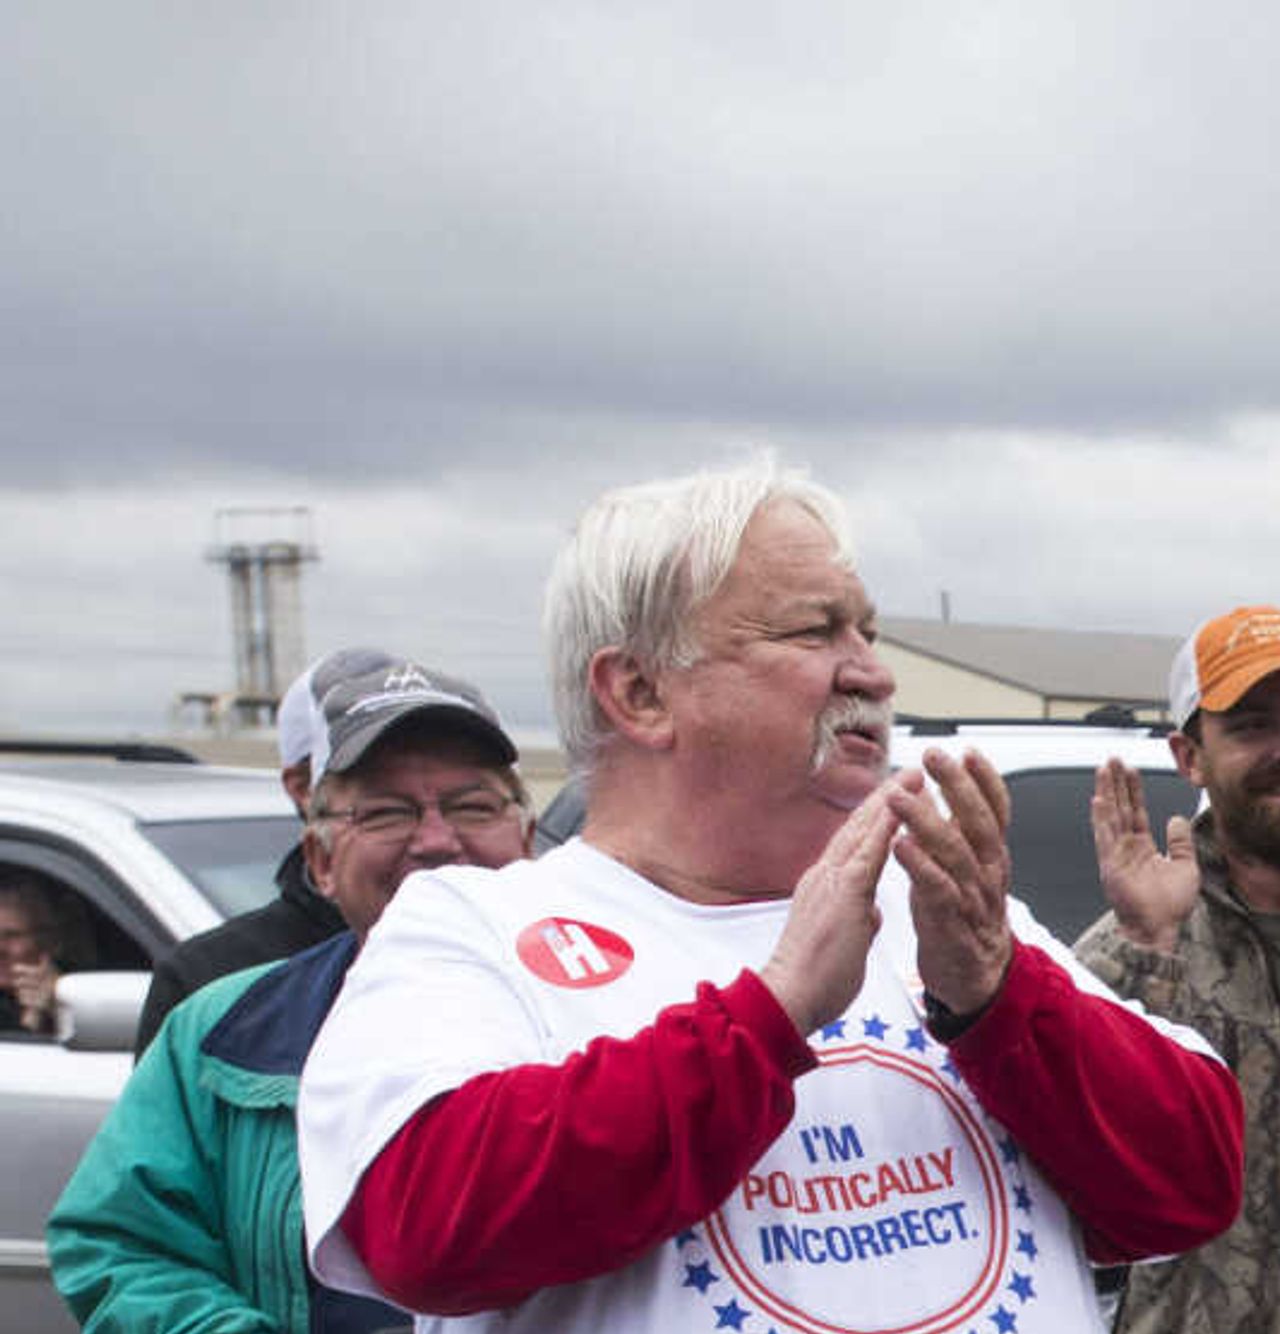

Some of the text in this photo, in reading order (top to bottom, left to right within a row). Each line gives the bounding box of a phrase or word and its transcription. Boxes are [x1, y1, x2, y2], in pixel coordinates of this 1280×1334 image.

[542, 923, 612, 981] H
[799, 1123, 865, 1164] I'M
[742, 1147, 956, 1214] POLITICALLY
[759, 1201, 980, 1265] INCORRECT.
